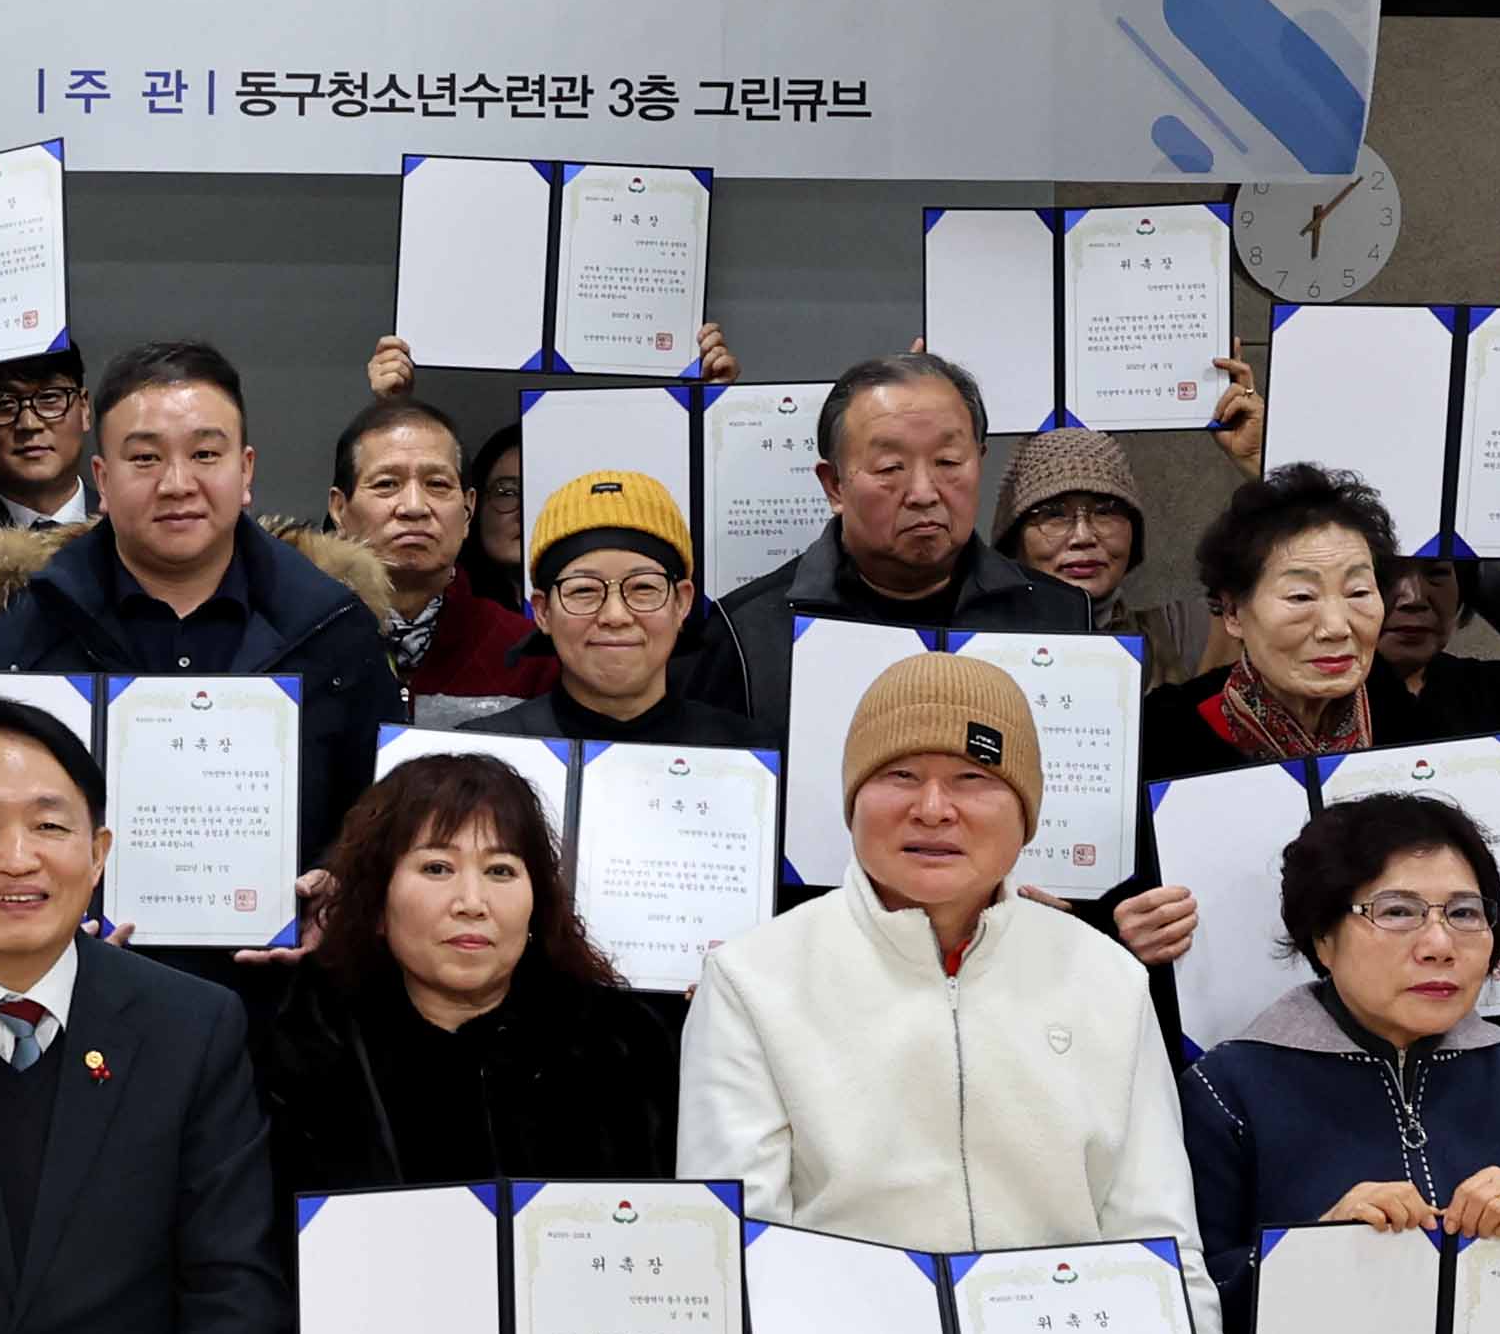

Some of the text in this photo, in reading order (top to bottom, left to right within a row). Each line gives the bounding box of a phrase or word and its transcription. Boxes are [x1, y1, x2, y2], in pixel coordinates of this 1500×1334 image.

[235, 71, 873, 123] 동구청소년수련관 3층 그린큐브
[1371, 171, 1385, 191] 2
[1240, 210, 1255, 228] 9
[1380, 207, 1394, 227] 3
[1249, 245, 1263, 266] 8
[1367, 242, 1381, 262] 4
[1274, 270, 1289, 290] 7
[1343, 268, 1357, 288] 5
[1307, 279, 1321, 298] 6
